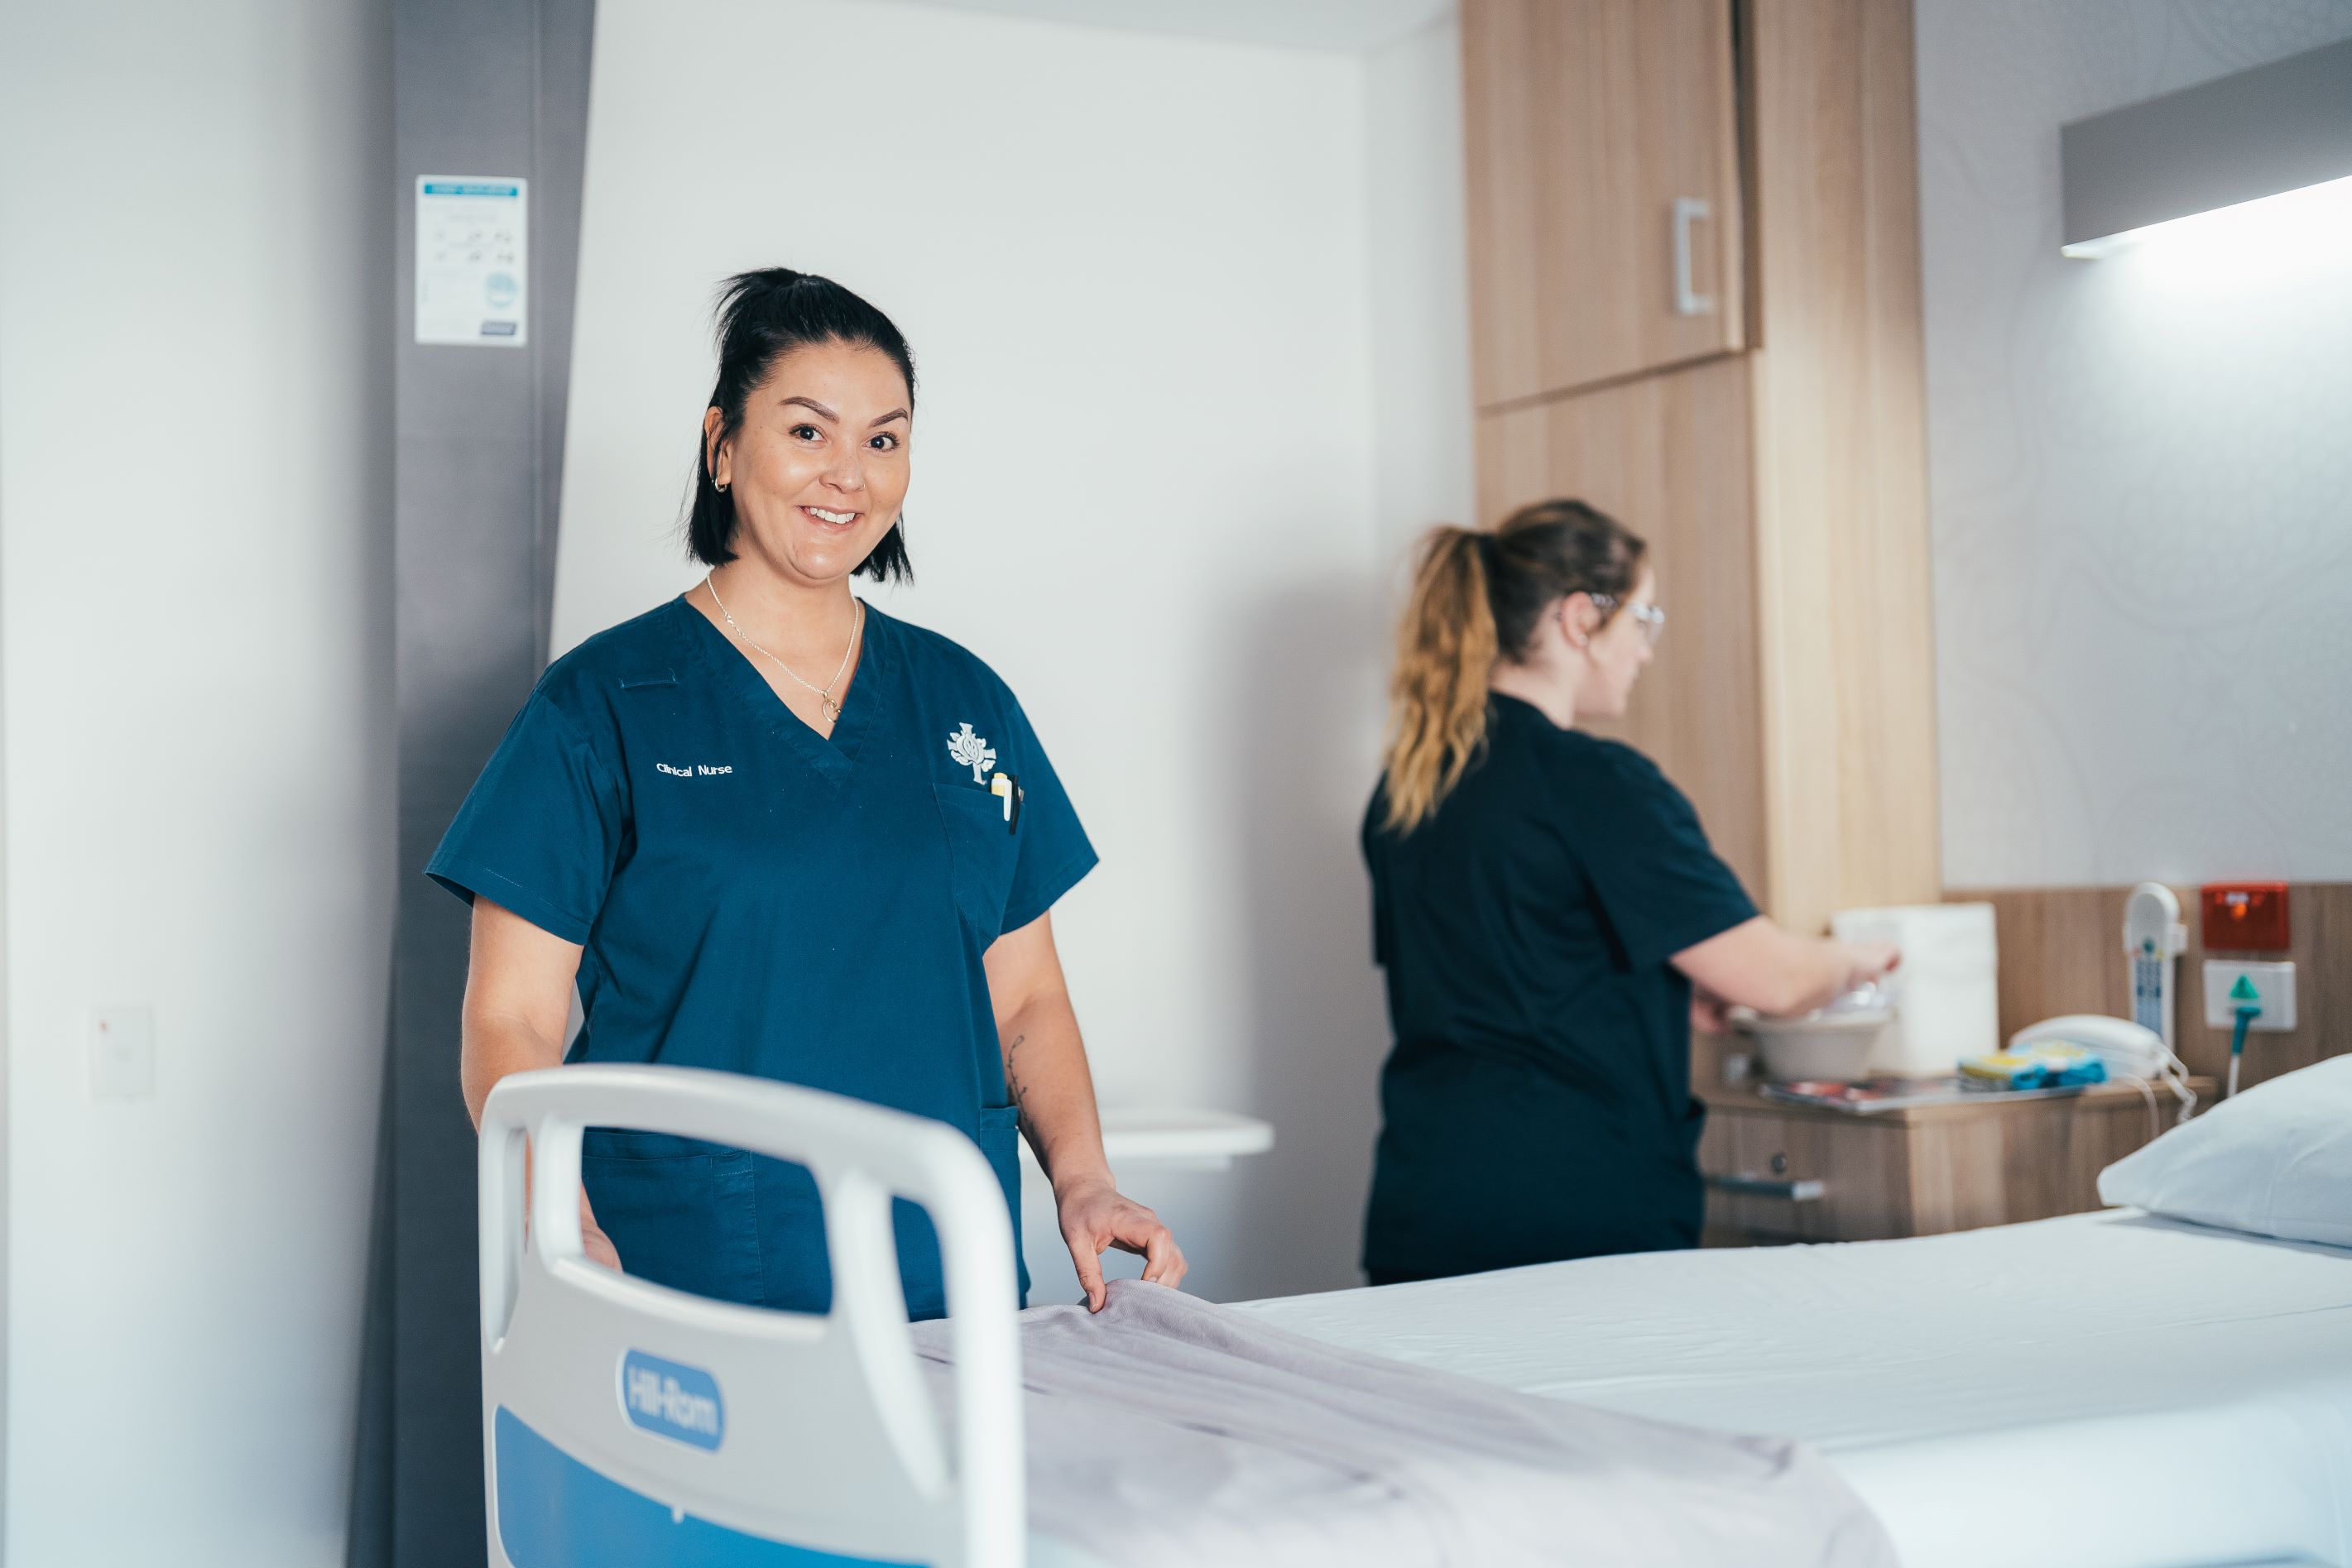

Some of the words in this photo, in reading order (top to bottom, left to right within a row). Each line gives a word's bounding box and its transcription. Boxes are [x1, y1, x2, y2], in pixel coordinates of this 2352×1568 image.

[656, 763, 693, 777] Clinical
[698, 765, 733, 776] Nurse
[628, 1365, 718, 1436] Hill-Rom
